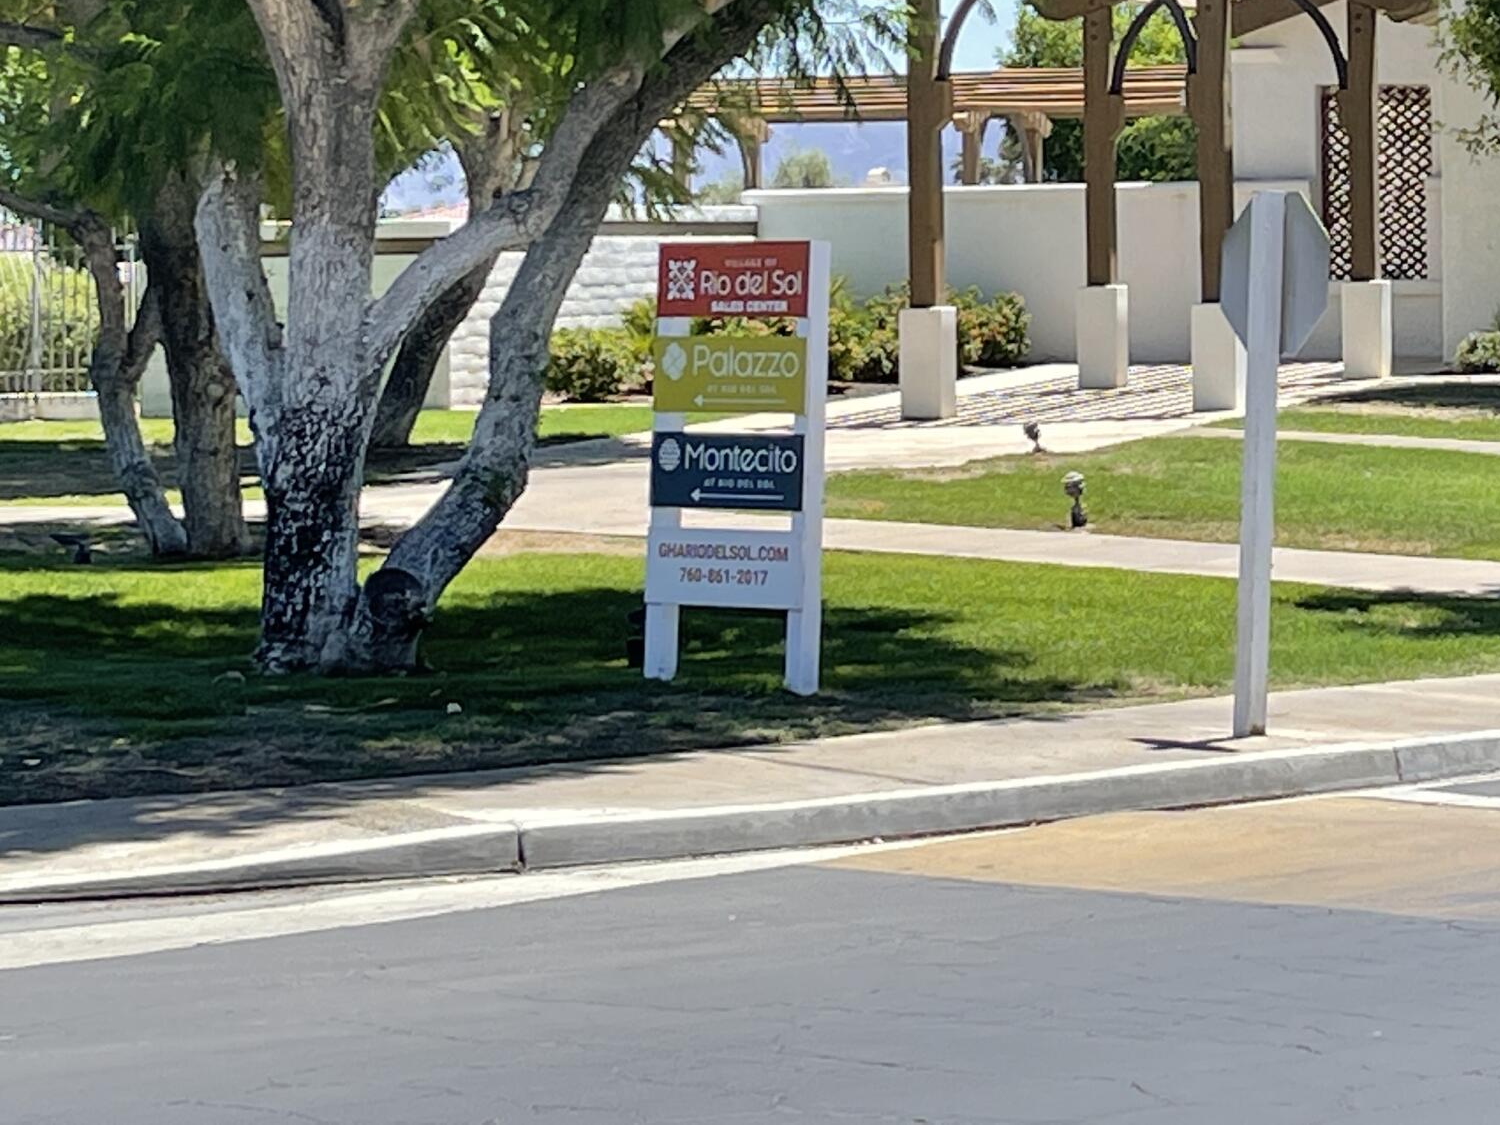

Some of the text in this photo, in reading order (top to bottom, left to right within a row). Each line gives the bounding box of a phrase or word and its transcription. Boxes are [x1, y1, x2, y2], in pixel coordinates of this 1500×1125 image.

[735, 270, 768, 296] del
[771, 269, 803, 296] Sol
[746, 300, 788, 312] CENTER
[692, 344, 800, 378] Palazzo
[684, 442, 797, 473] Montecito
